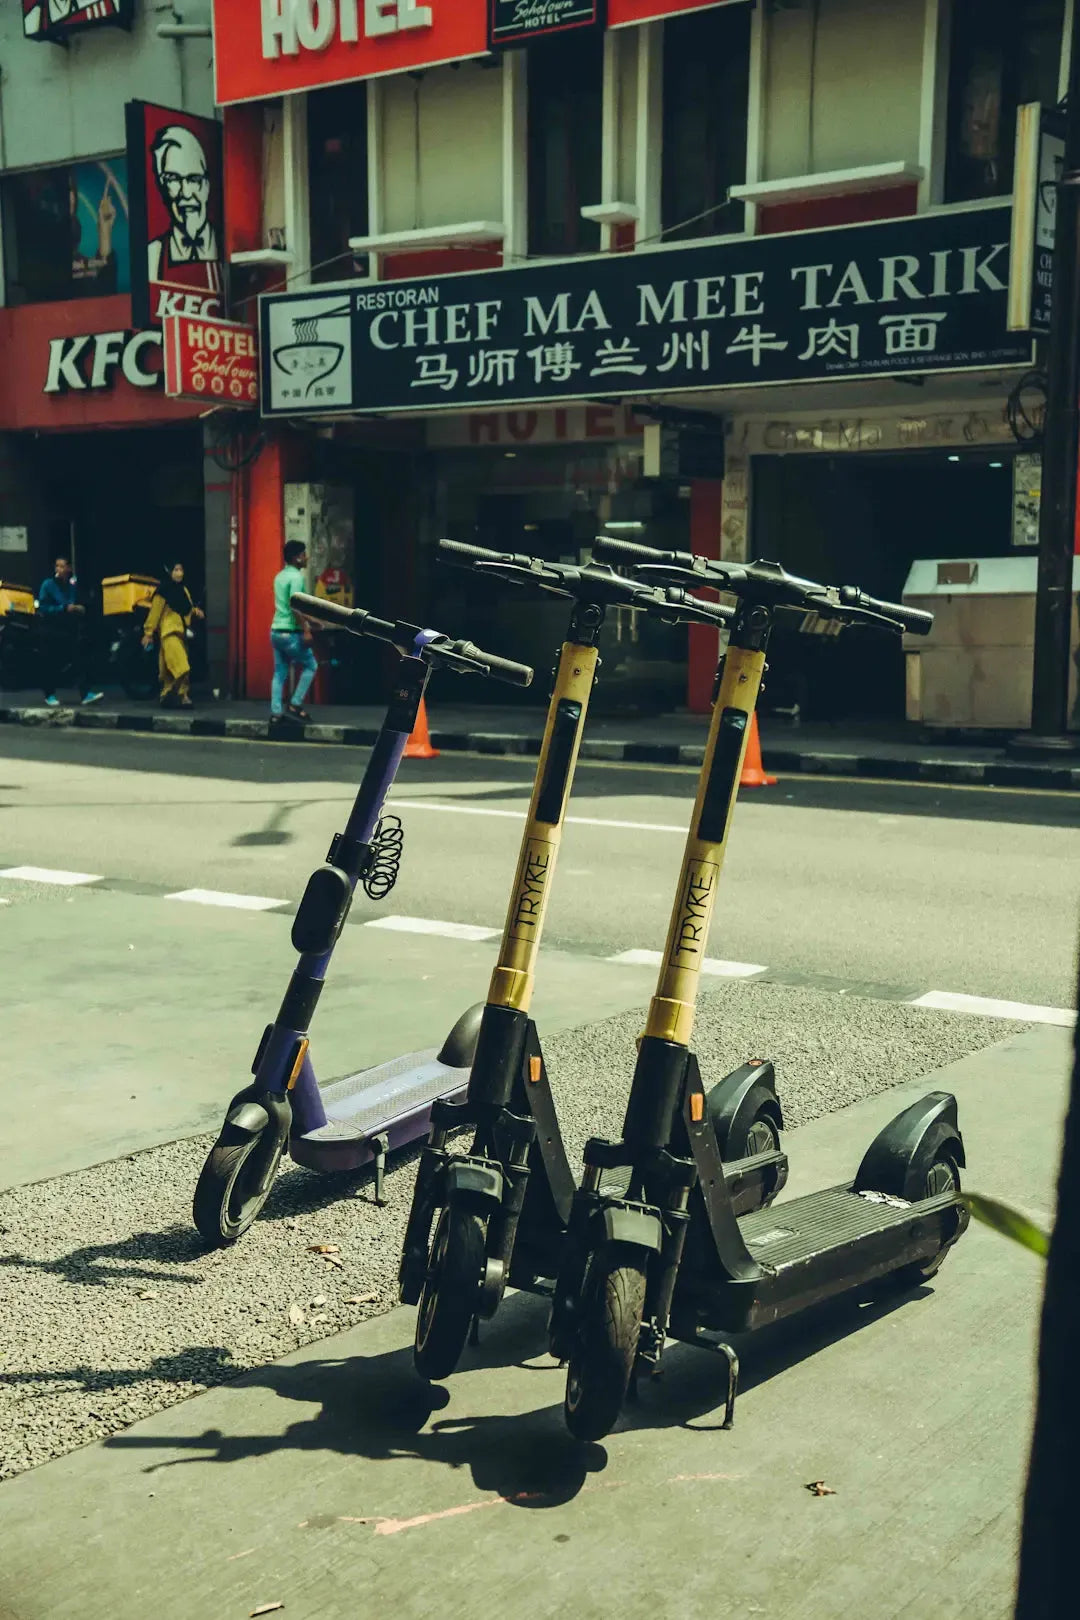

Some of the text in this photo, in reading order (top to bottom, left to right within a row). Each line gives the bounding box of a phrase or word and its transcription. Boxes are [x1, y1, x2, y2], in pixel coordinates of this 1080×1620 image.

[524, 13, 561, 28] HOTEL
[356, 286, 440, 312] RESTORAN
[369, 300, 502, 351] CHEF
[522, 290, 613, 337] MA
[635, 271, 765, 326] MEE
[790, 243, 1009, 310] TARIK
[43, 330, 163, 392] KFC
[187, 323, 257, 357] HOTEL
[514, 851, 551, 928] TRYKE
[675, 872, 713, 957] TRYKE
